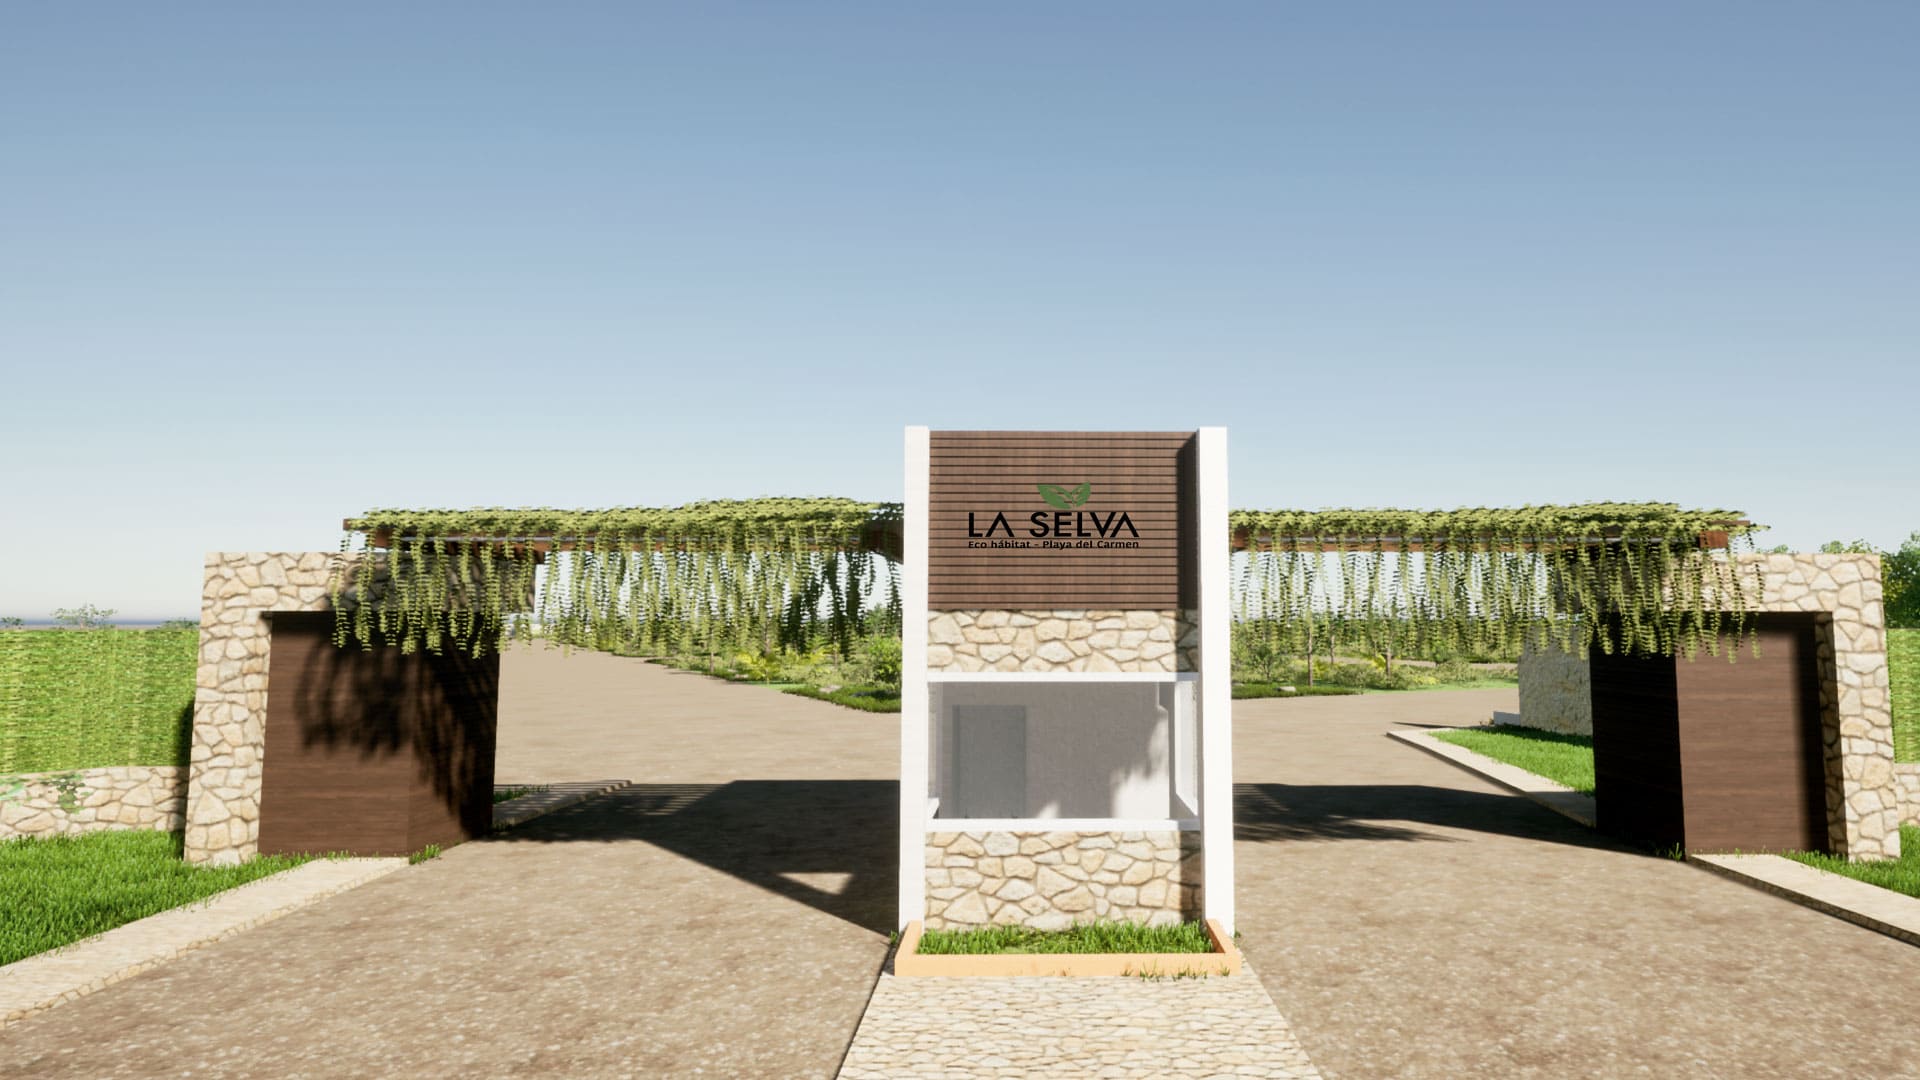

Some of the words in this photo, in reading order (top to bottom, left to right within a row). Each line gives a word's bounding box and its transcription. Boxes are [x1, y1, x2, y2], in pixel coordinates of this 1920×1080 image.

[968, 511, 1015, 538] LA
[1029, 511, 1140, 538] SELVA
[968, 540, 988, 549] Eco
[991, 539, 1031, 549] hábitat
[1042, 540, 1072, 551] Playa
[1075, 540, 1093, 549] del
[1097, 540, 1140, 549] Carmen
